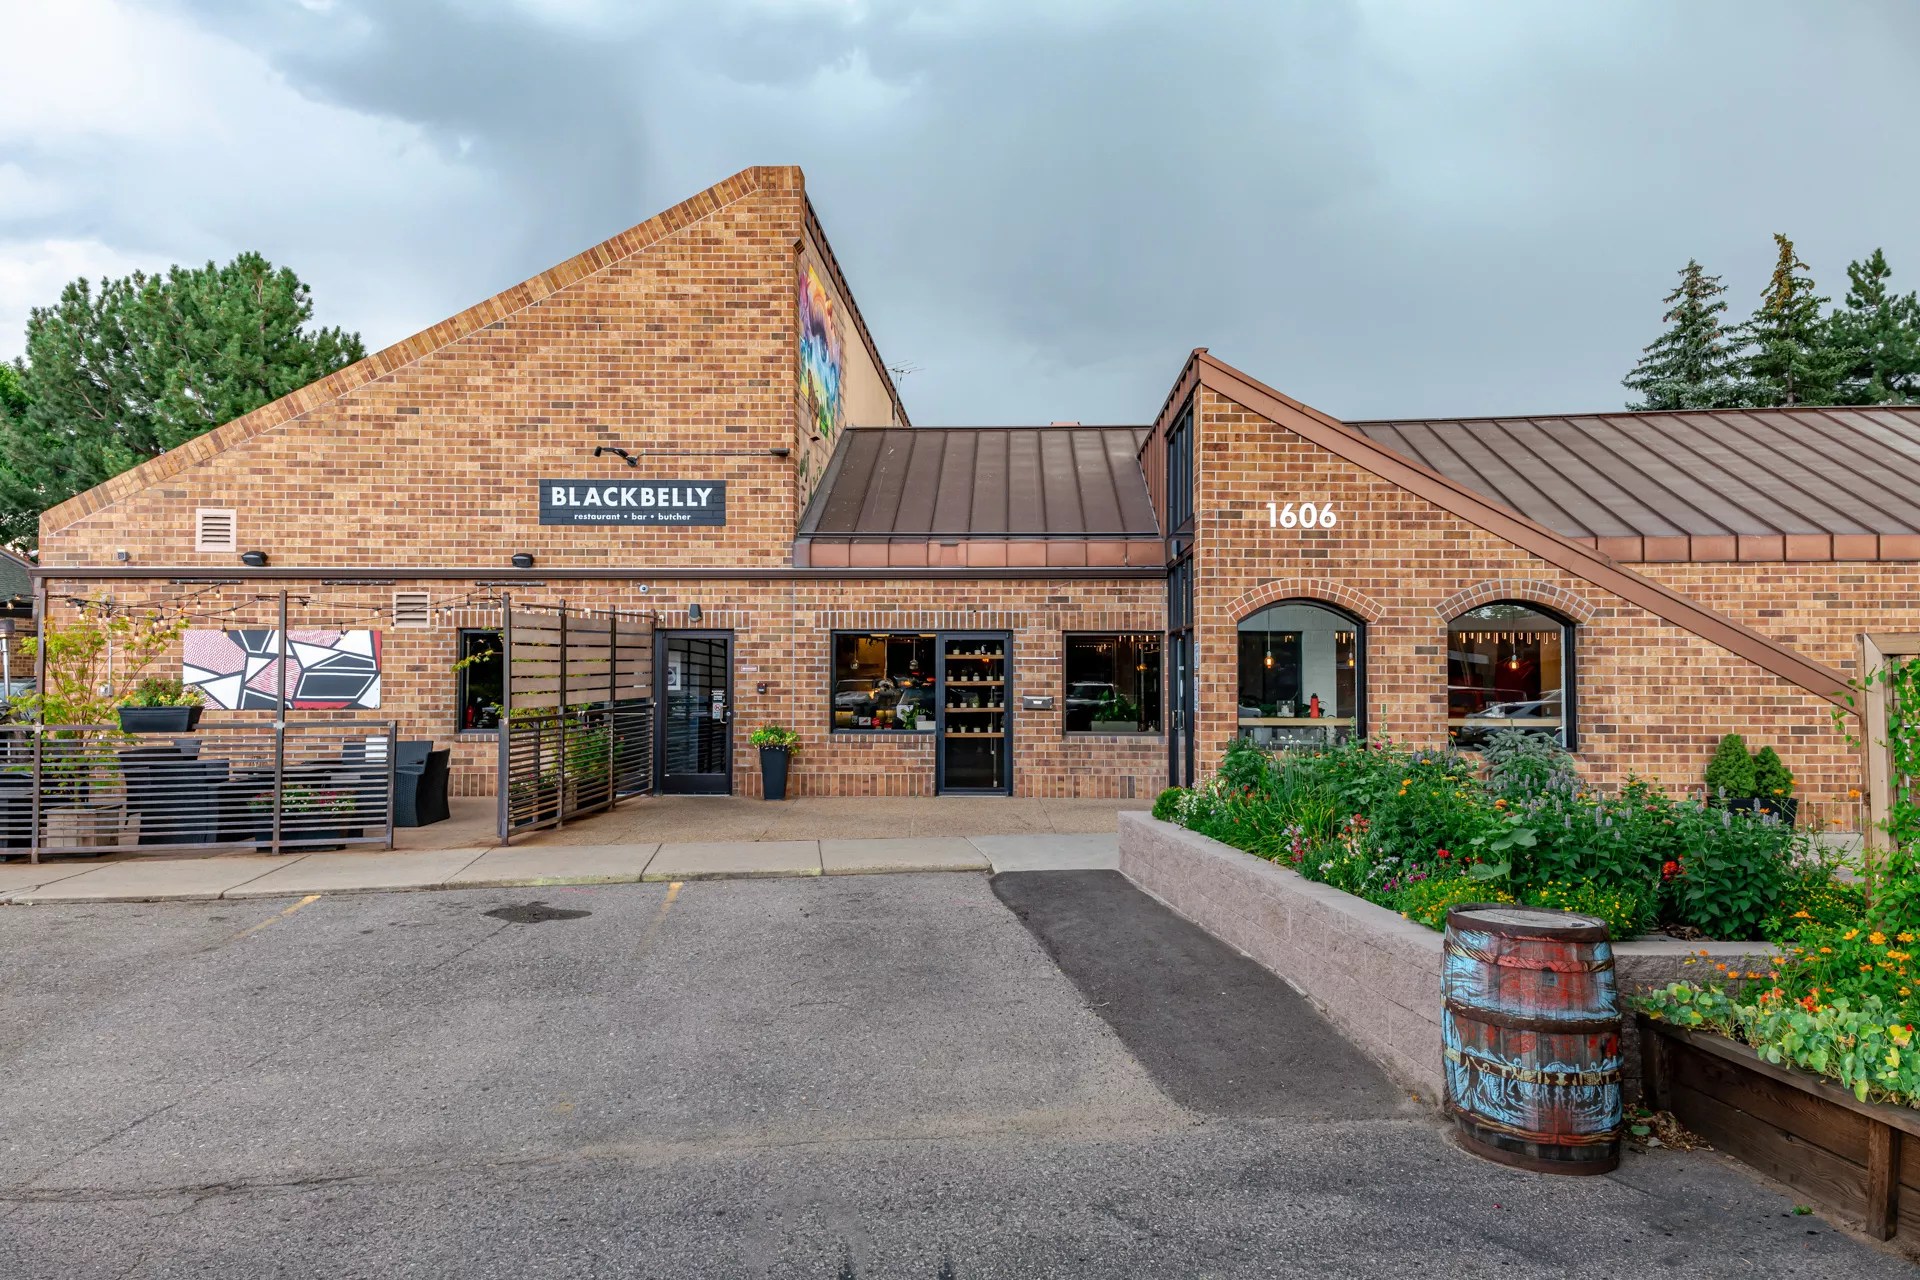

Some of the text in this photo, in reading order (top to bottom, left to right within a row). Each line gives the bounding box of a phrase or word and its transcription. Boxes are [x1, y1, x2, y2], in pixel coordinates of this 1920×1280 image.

[551, 486, 713, 507] BLACKBELLY
[574, 512, 692, 521] restaurant bar butcher
[1265, 502, 1337, 529] 1606
